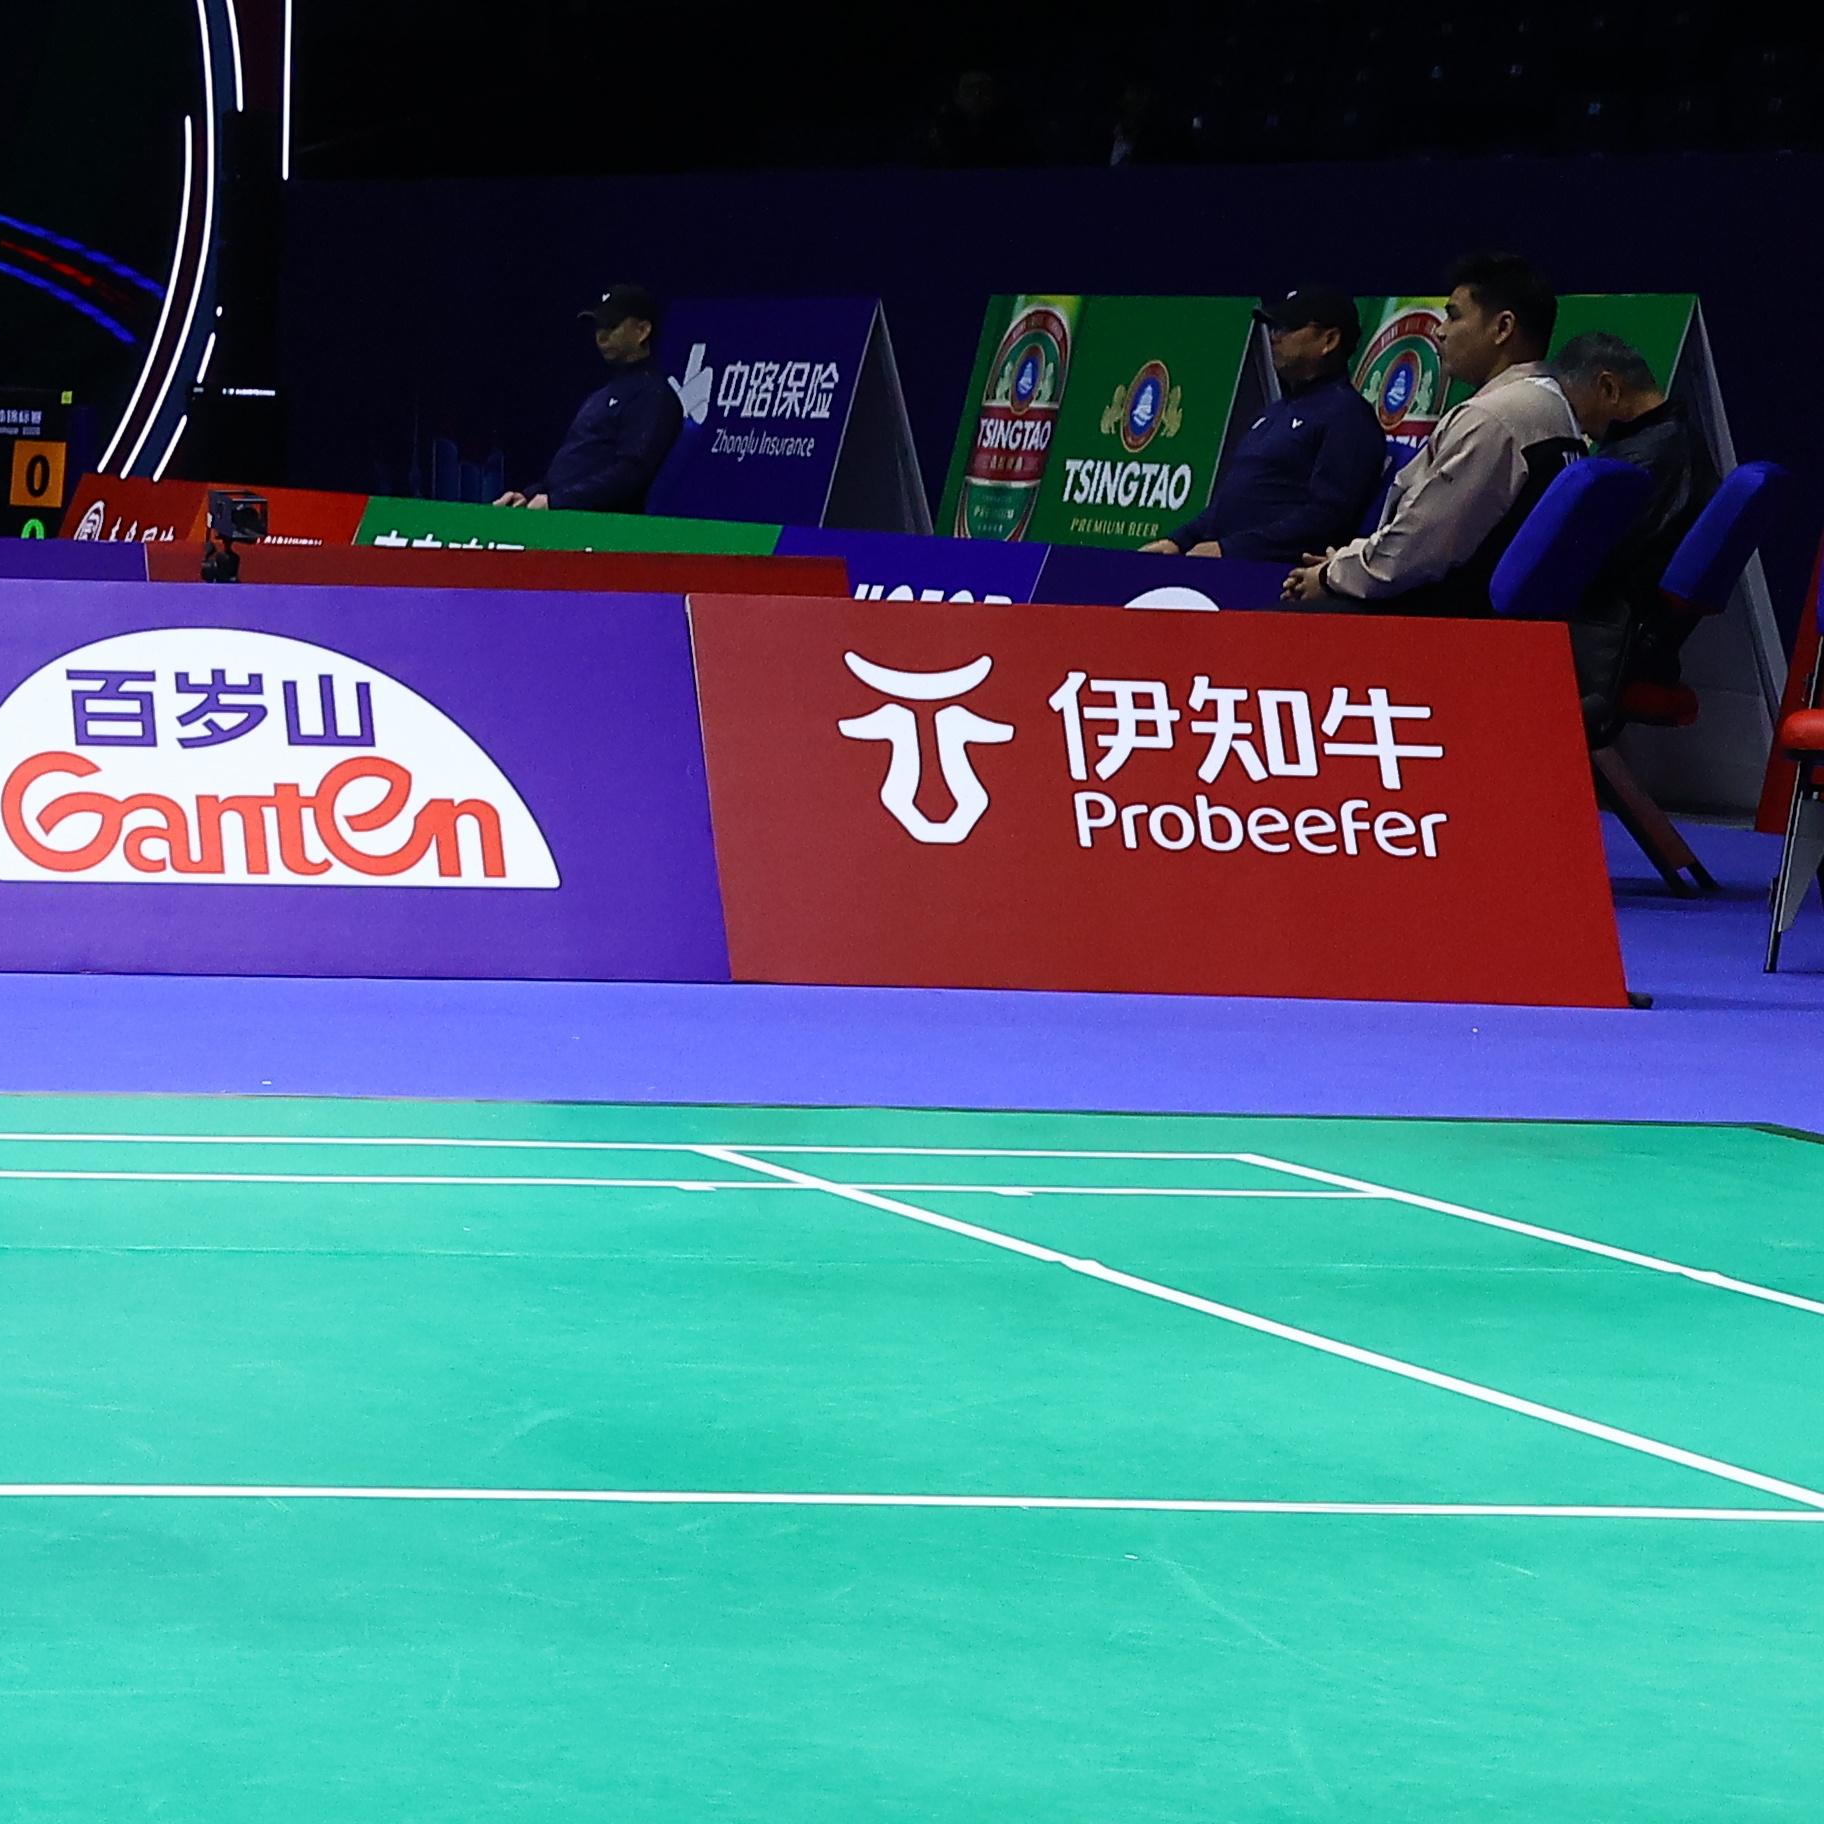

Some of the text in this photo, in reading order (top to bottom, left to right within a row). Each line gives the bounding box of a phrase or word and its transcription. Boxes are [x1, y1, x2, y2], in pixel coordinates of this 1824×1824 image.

[717, 360, 840, 420] 中路保险
[710, 427, 816, 462] Zhonglu Insurance
[976, 418, 1052, 451] TSINGTAO
[25, 454, 51, 498] 0
[1062, 458, 1193, 512] TSINGTAO
[1069, 517, 1159, 537] PREMIUM BEER
[65, 668, 377, 749] 百岁山
[1048, 670, 1445, 791] 伊知牛
[1072, 789, 1449, 859] Probeefer
